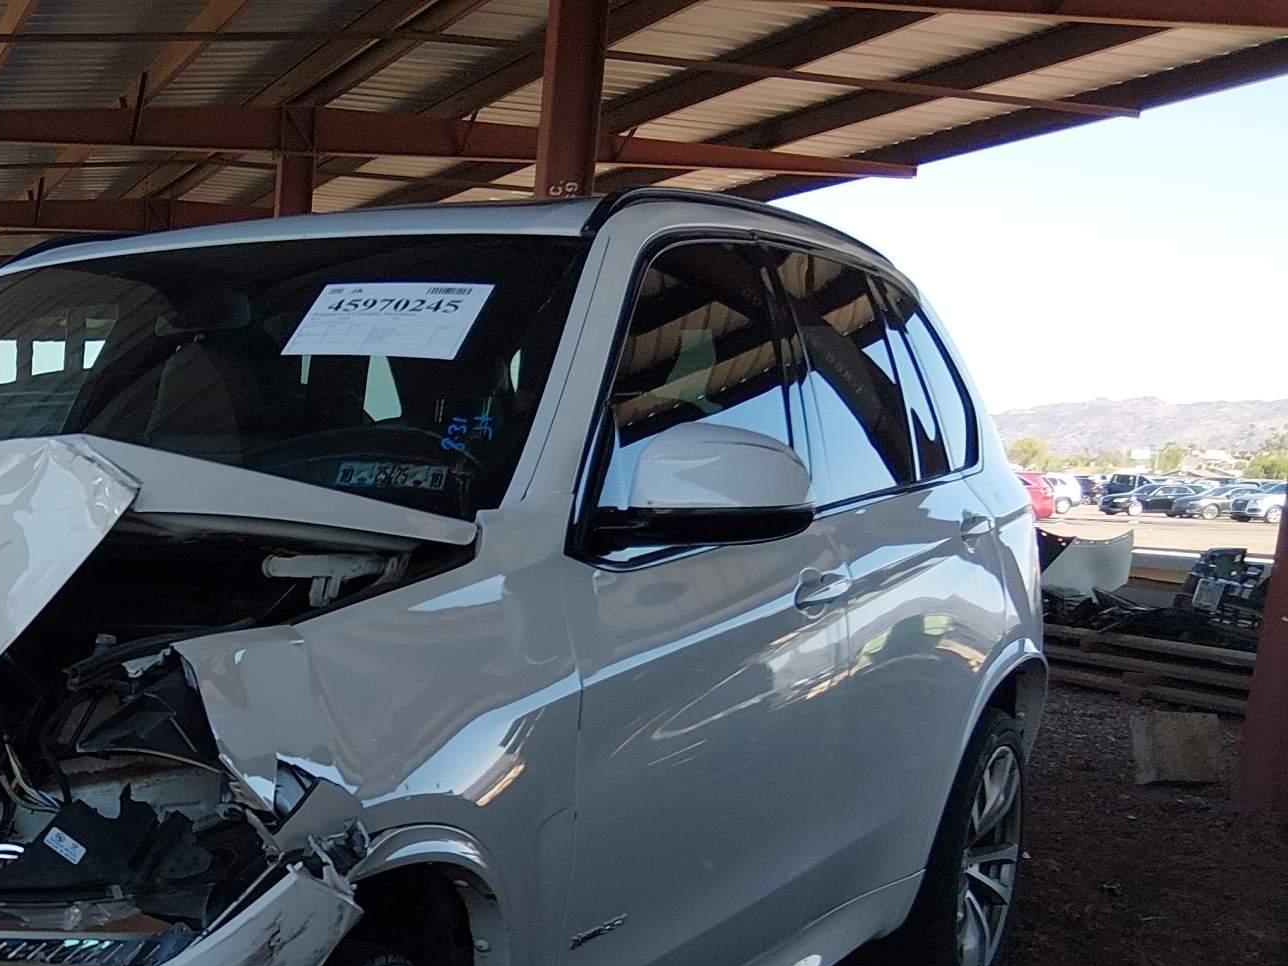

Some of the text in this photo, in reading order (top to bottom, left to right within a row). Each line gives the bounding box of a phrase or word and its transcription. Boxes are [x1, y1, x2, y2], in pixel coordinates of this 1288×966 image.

[327, 297, 463, 314] 45970245
[374, 466, 389, 482] 25
[393, 466, 409, 484] 25
